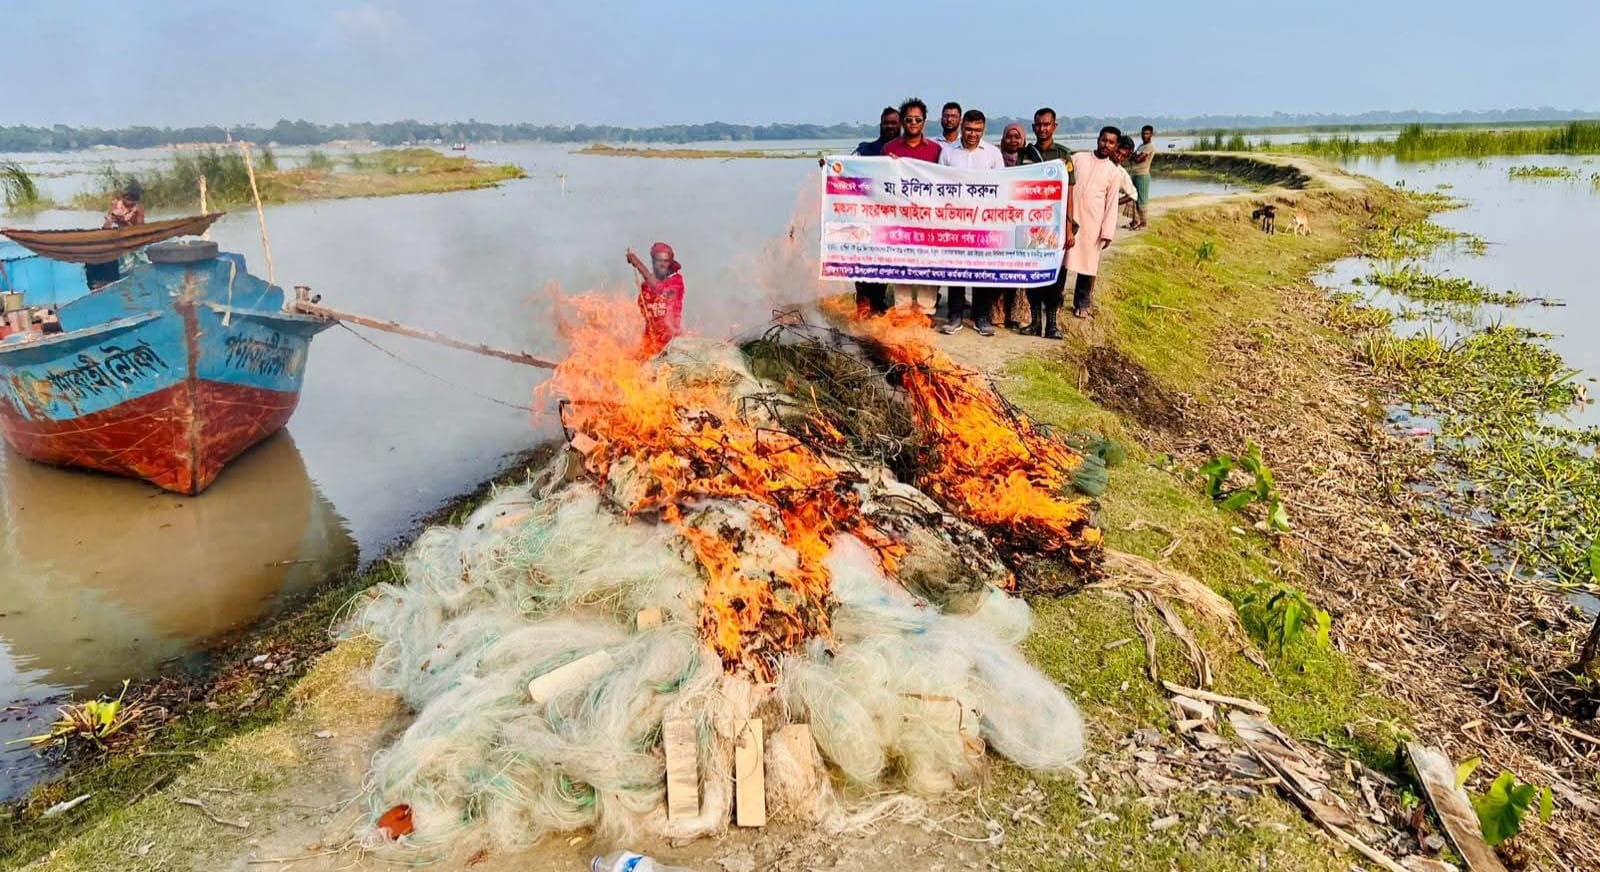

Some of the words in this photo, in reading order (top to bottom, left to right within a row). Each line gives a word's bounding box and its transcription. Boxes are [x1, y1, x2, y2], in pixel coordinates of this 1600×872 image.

[883, 181, 896, 196] মা
[900, 177, 933, 197] ইলিশ
[936, 183, 962, 198] রক্ষা
[966, 183, 999, 198] করুন
[861, 203, 897, 219] সংরক্ষণ
[899, 202, 931, 222] আইনে
[935, 203, 979, 224] অভিযান/
[982, 205, 1025, 223] মোবাইল
[1028, 205, 1054, 222] কোর্ট
[98, 338, 170, 385] নৌকা
